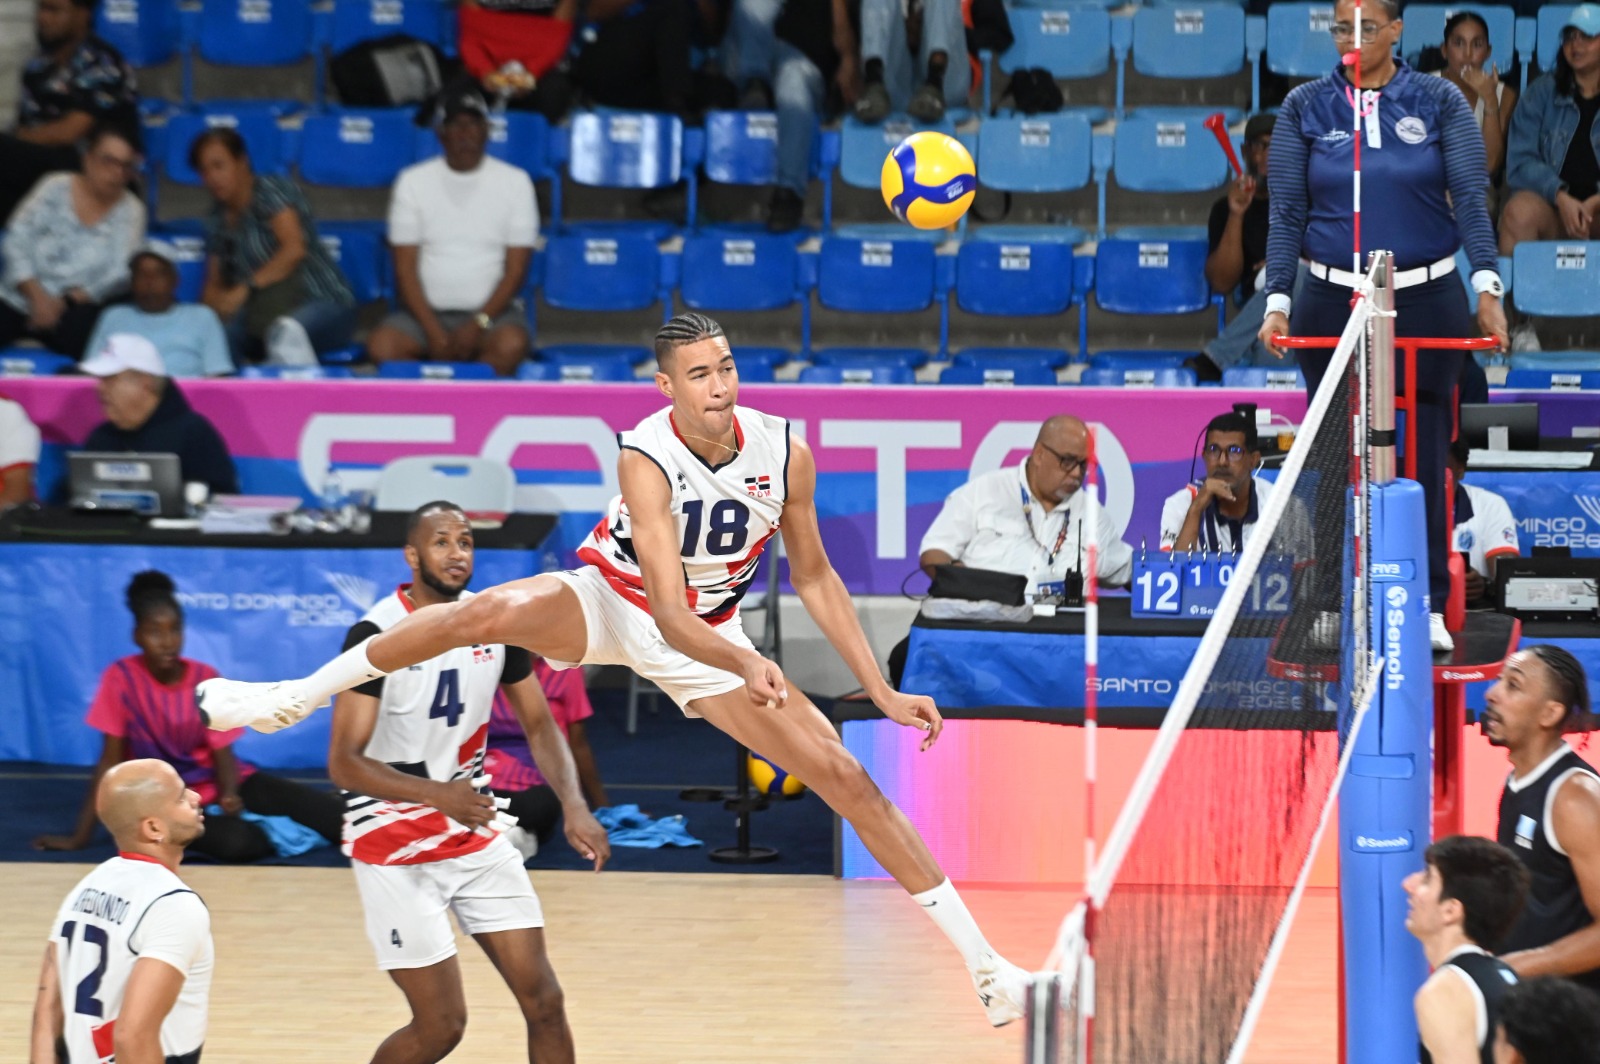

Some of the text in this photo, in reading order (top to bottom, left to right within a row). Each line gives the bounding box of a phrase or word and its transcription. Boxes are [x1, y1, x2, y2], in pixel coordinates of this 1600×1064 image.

[681, 499, 750, 558] 18
[1535, 534, 1600, 549] 2026
[1137, 565, 1289, 611] 12 1 0 12
[232, 593, 341, 610] DOMINGO
[289, 610, 357, 625] 2026
[1387, 609, 1405, 690] Senoh
[1086, 677, 1172, 693] SANTO
[1451, 671, 1485, 680] Senoh
[429, 668, 466, 728] 4
[1366, 836, 1409, 848] Senoh
[391, 928, 403, 949] 4
[61, 920, 109, 1020] 12
